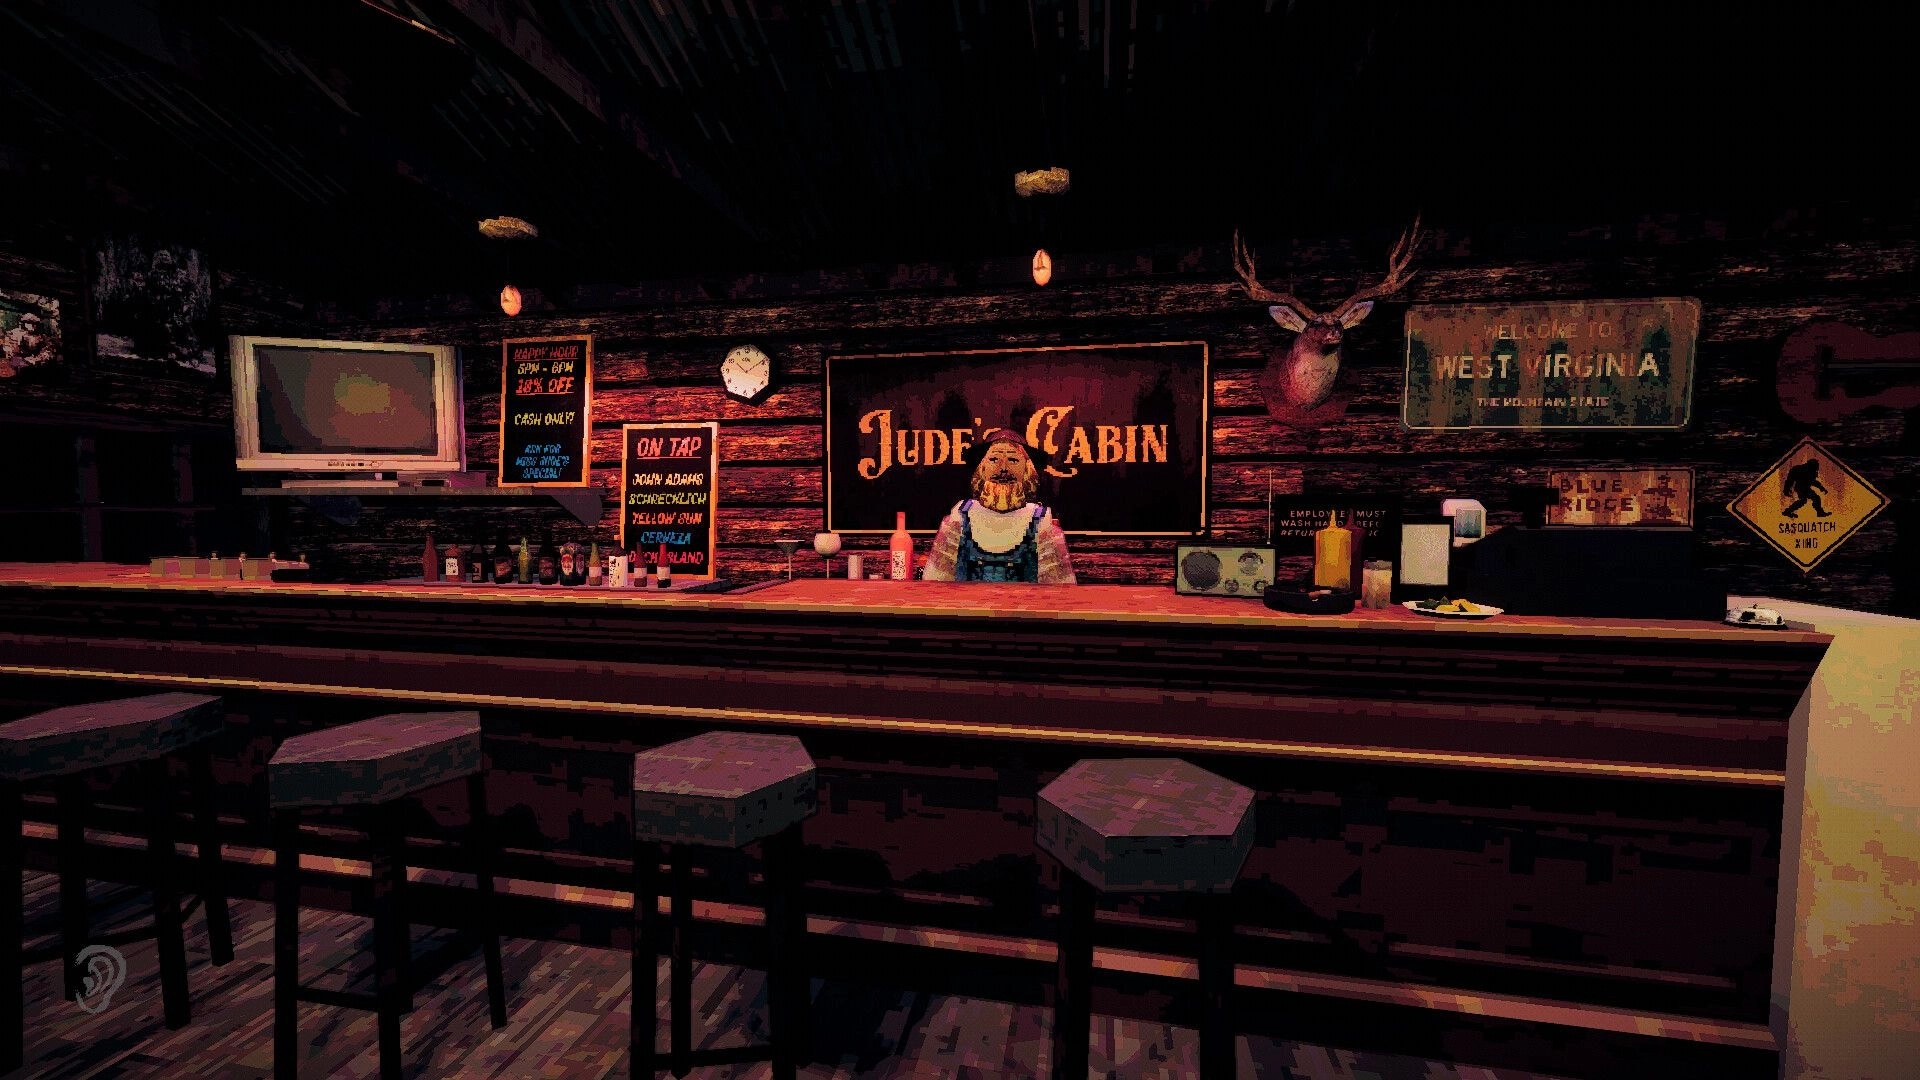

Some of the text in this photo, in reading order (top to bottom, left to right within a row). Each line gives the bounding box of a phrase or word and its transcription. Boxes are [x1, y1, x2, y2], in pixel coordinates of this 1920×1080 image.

[1483, 320, 1612, 339] WELCOME TO
[1436, 352, 1660, 379] WEST VIRGINIA
[548, 376, 575, 393] OFF
[1477, 397, 1500, 407] THE
[1570, 396, 1610, 407] STATE
[514, 412, 542, 426] CASH
[637, 436, 702, 456] ON TAP
[857, 405, 1169, 480] JUDE' CABIN
[632, 472, 704, 486] JOHN ADAMS
[1559, 479, 1634, 512] BLUE RIDGE
[632, 511, 703, 525] YELLOW SUN
[1356, 509, 1387, 518] MUST
[1280, 519, 1312, 528] WASH
[1778, 521, 1837, 534] SASQUATCH
[640, 531, 692, 545] CERVEZA
[1794, 537, 1819, 550] XING
